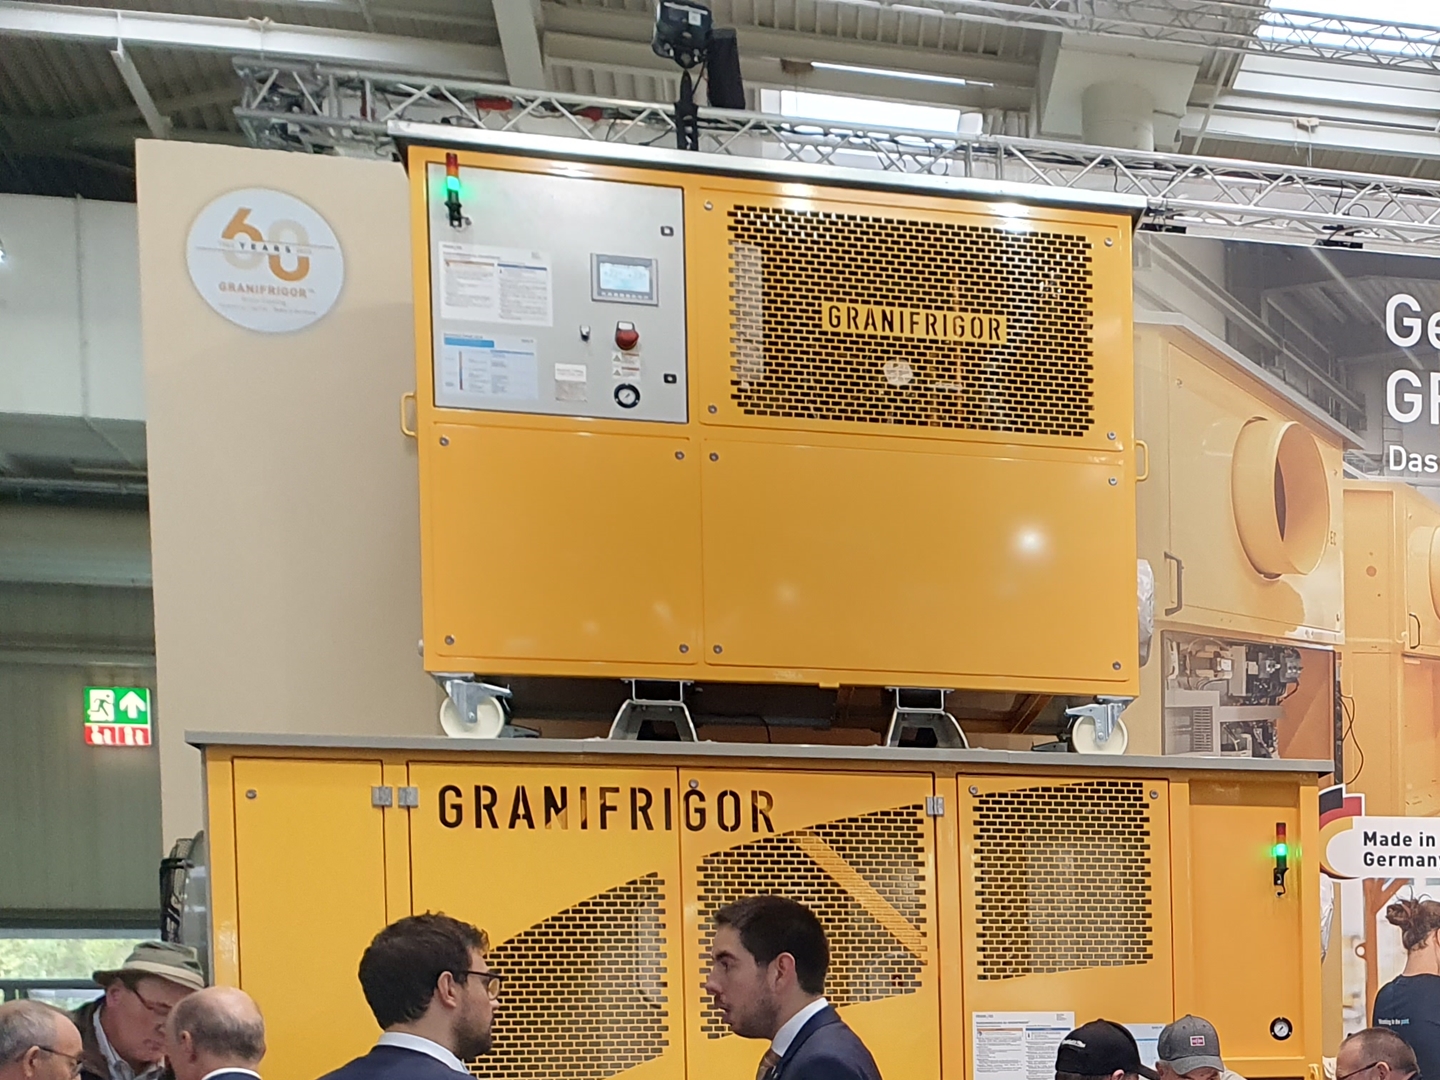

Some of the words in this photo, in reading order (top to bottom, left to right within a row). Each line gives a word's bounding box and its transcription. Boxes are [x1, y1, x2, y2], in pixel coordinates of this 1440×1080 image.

[827, 304, 1002, 342] GRANIFRIGOR
[1389, 444, 1439, 475] Das
[437, 785, 775, 833] GRANIFRIGOR
[1363, 831, 1413, 847] Made
[1419, 831, 1436, 847] in
